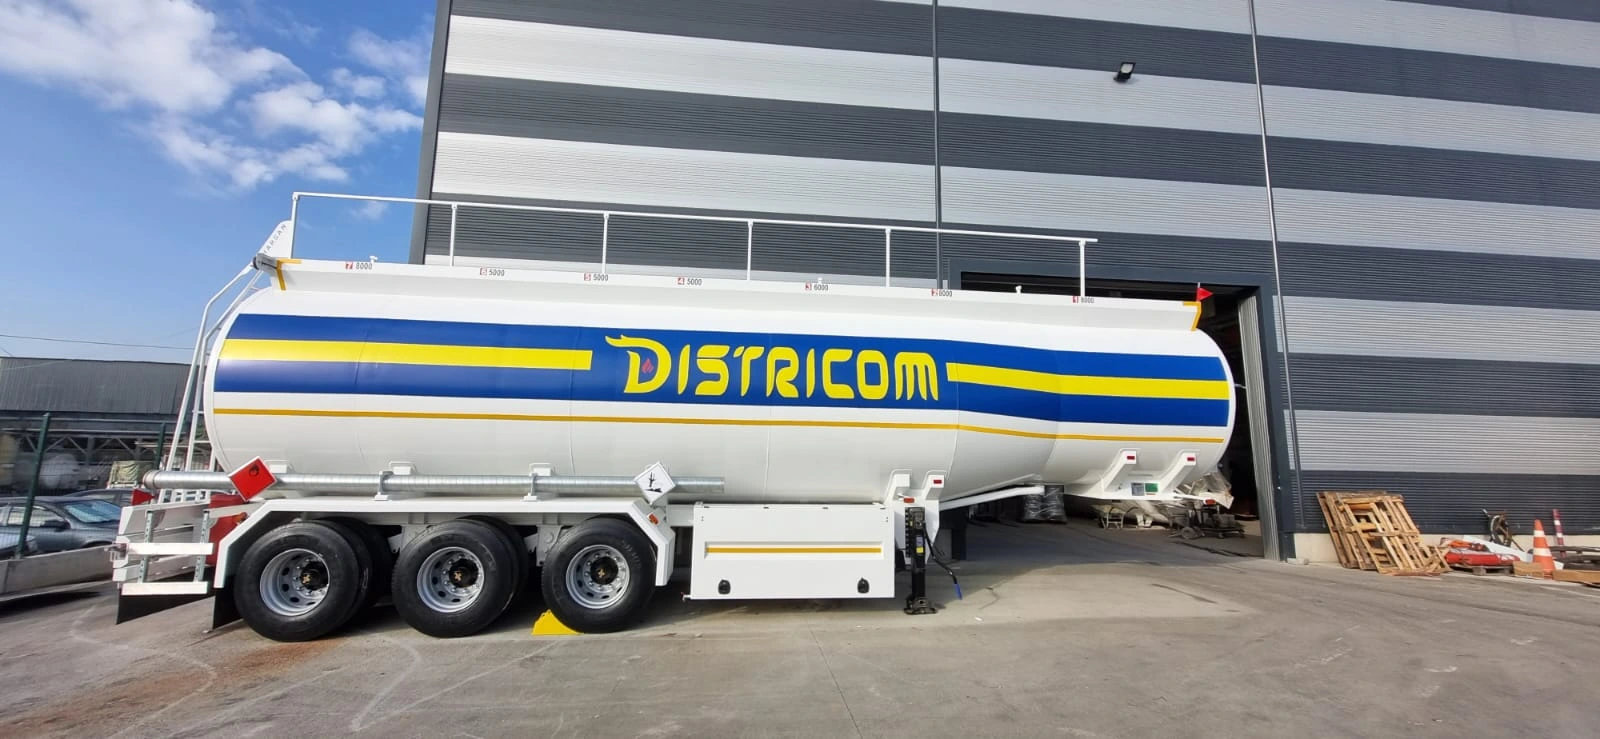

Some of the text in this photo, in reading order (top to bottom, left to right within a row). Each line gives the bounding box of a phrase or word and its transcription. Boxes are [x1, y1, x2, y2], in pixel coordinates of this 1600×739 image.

[489, 268, 505, 276] 5000
[687, 278, 702, 286] 5000
[605, 334, 939, 401] DISTRICOM
